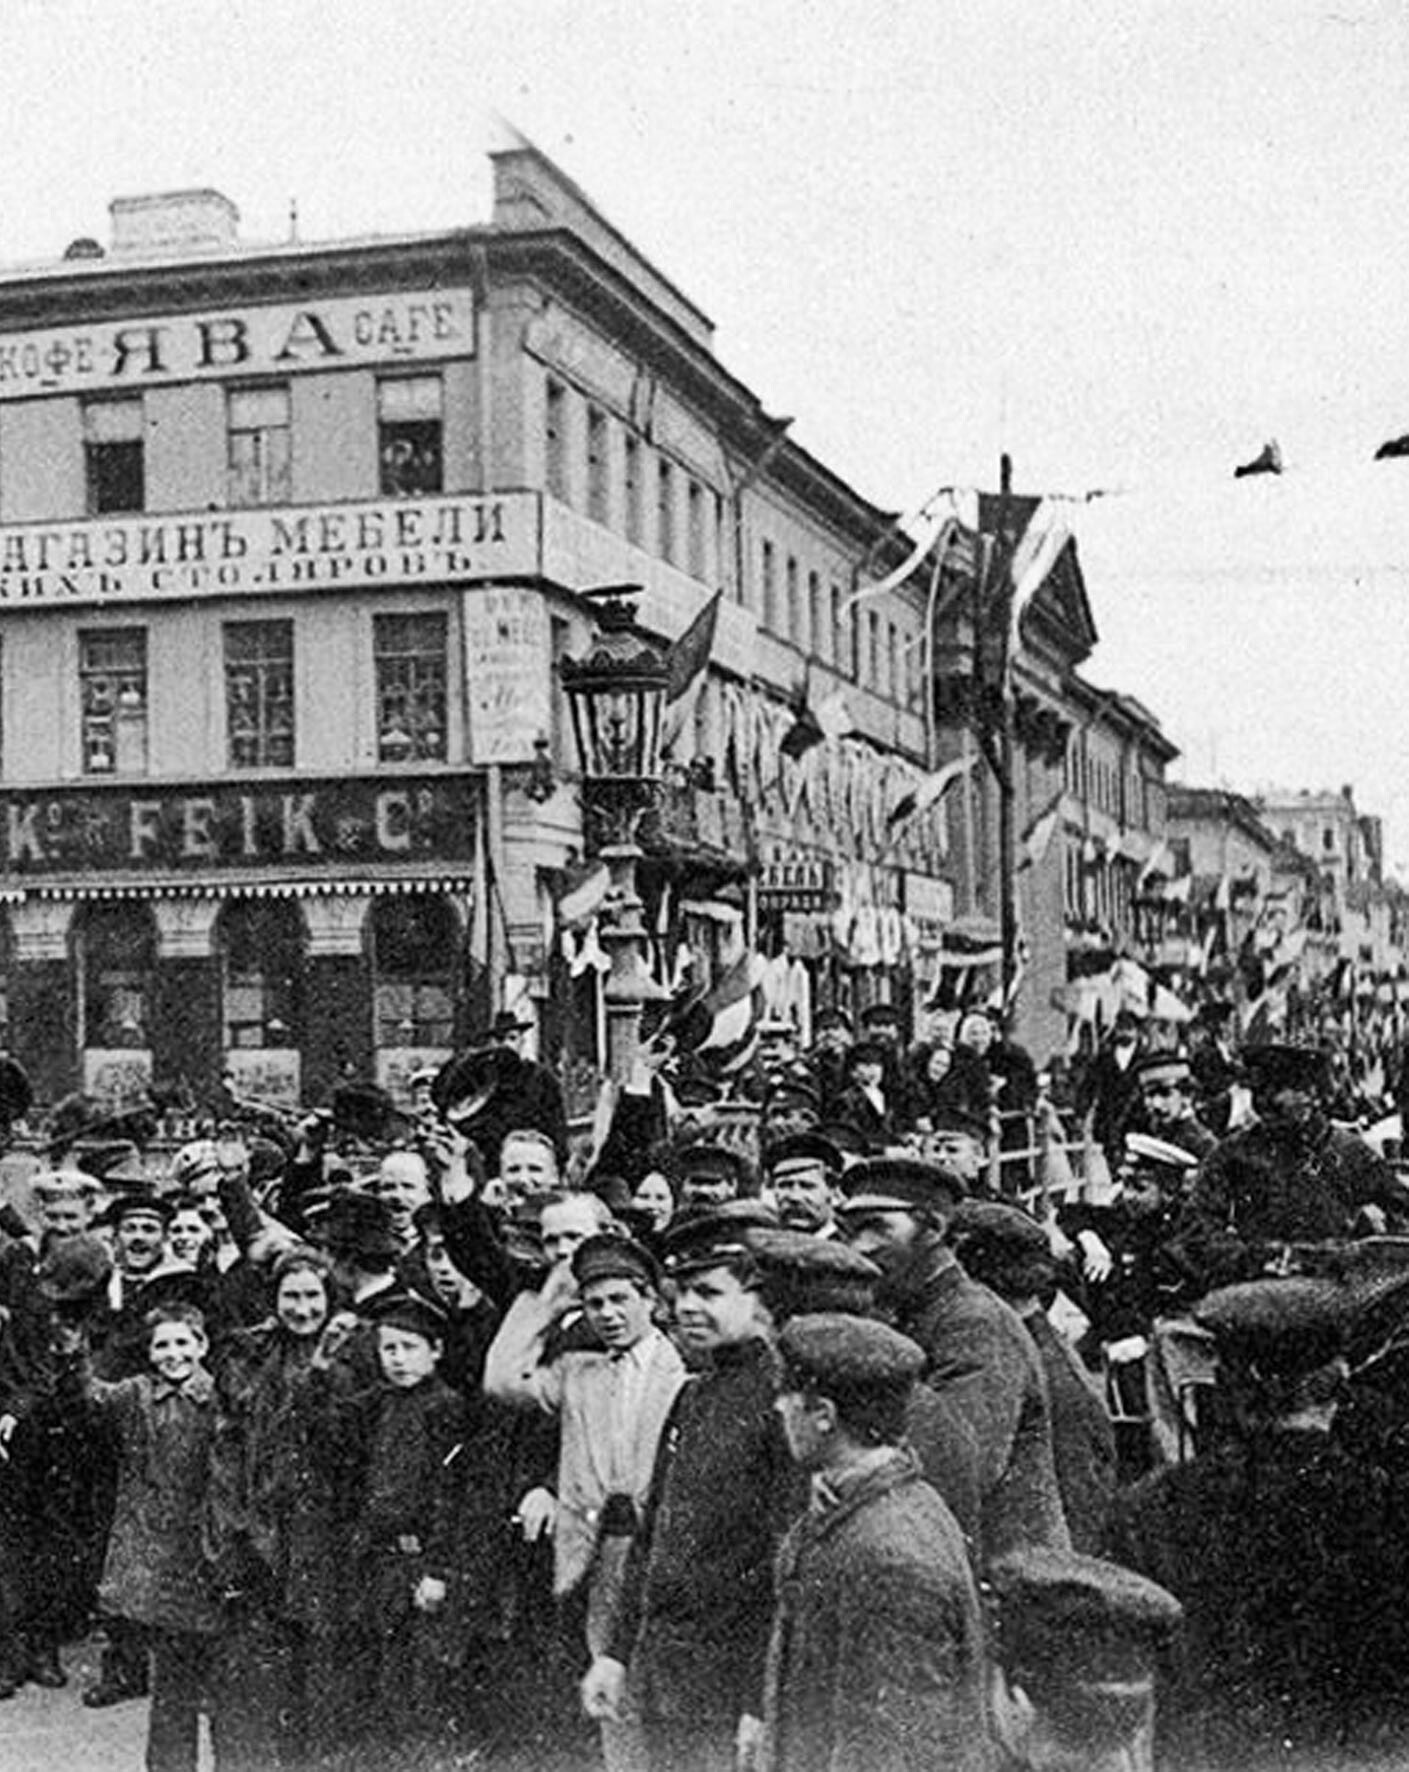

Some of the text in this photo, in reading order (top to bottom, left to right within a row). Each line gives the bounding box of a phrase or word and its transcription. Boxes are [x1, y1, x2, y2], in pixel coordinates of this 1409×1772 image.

[108, 310, 345, 377] ЯВА
[270, 502, 506, 557] МЕБЕЛИ
[151, 549, 472, 590] СТОЛЯРОВЪ
